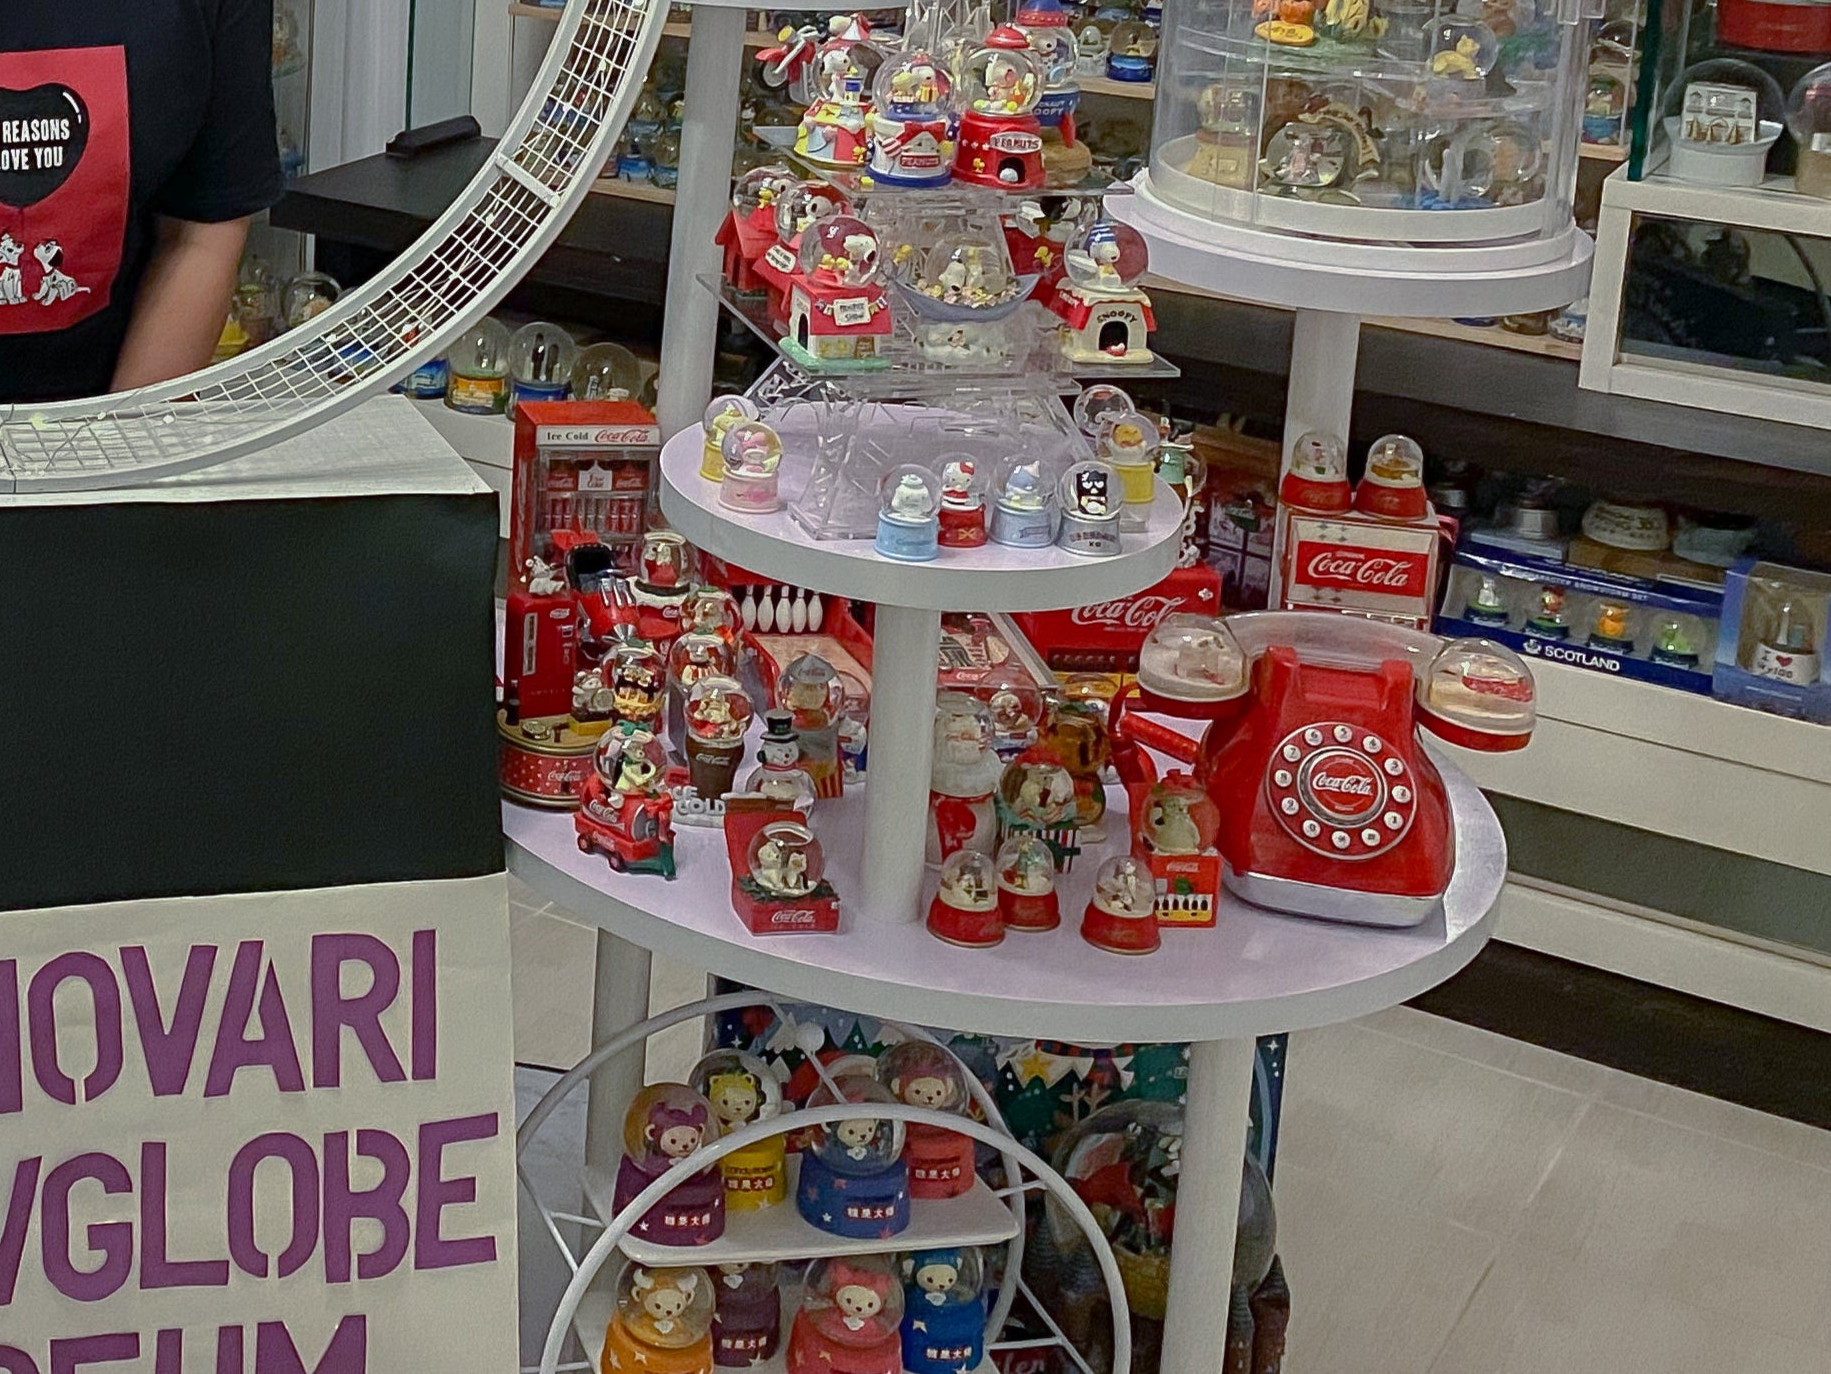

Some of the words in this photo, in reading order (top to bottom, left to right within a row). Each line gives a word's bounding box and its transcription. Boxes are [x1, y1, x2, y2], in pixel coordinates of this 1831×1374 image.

[2, 119, 70, 143] REASONS
[993, 137, 1039, 150] PEANUTS
[34, 146, 63, 169] YOU
[547, 432, 562, 441] Ice
[565, 432, 589, 441] Cold
[1307, 551, 1412, 587] Coca-Cola
[1071, 596, 1188, 626] Coca-Col
[1545, 645, 1621, 672] SCOTLAND
[676, 798, 727, 816] COLD
